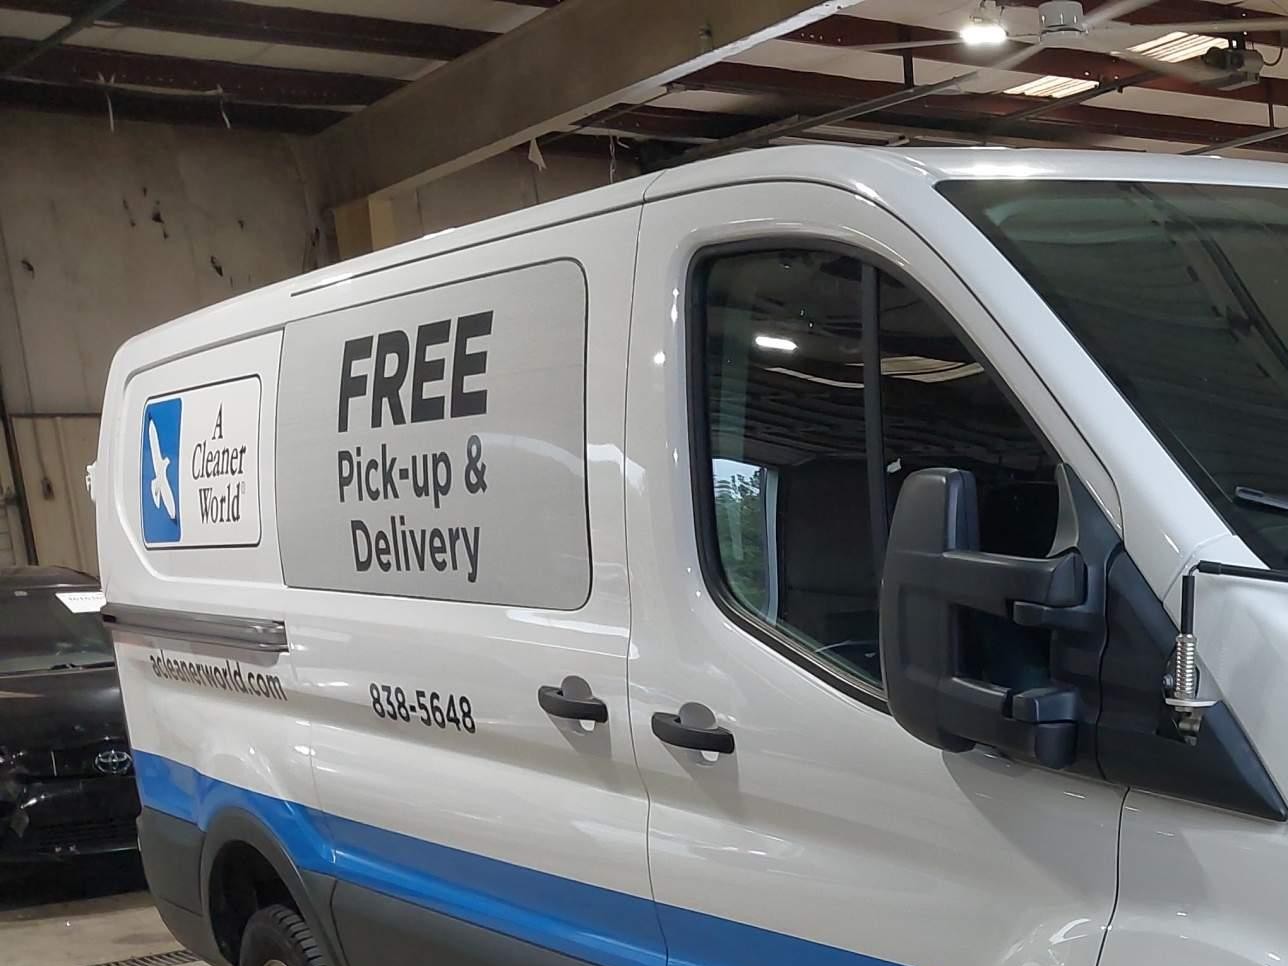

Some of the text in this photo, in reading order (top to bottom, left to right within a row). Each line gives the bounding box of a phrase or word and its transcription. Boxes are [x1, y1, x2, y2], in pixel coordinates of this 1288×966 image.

[337, 309, 495, 433] FREE
[211, 402, 224, 441] A
[191, 439, 247, 480] Cleaner
[337, 434, 488, 509] Pick-up &
[198, 482, 241, 525] World
[350, 514, 481, 584] Delivery
[149, 649, 289, 702] acleanerworld.com
[368, 682, 477, 735] 838-5648
